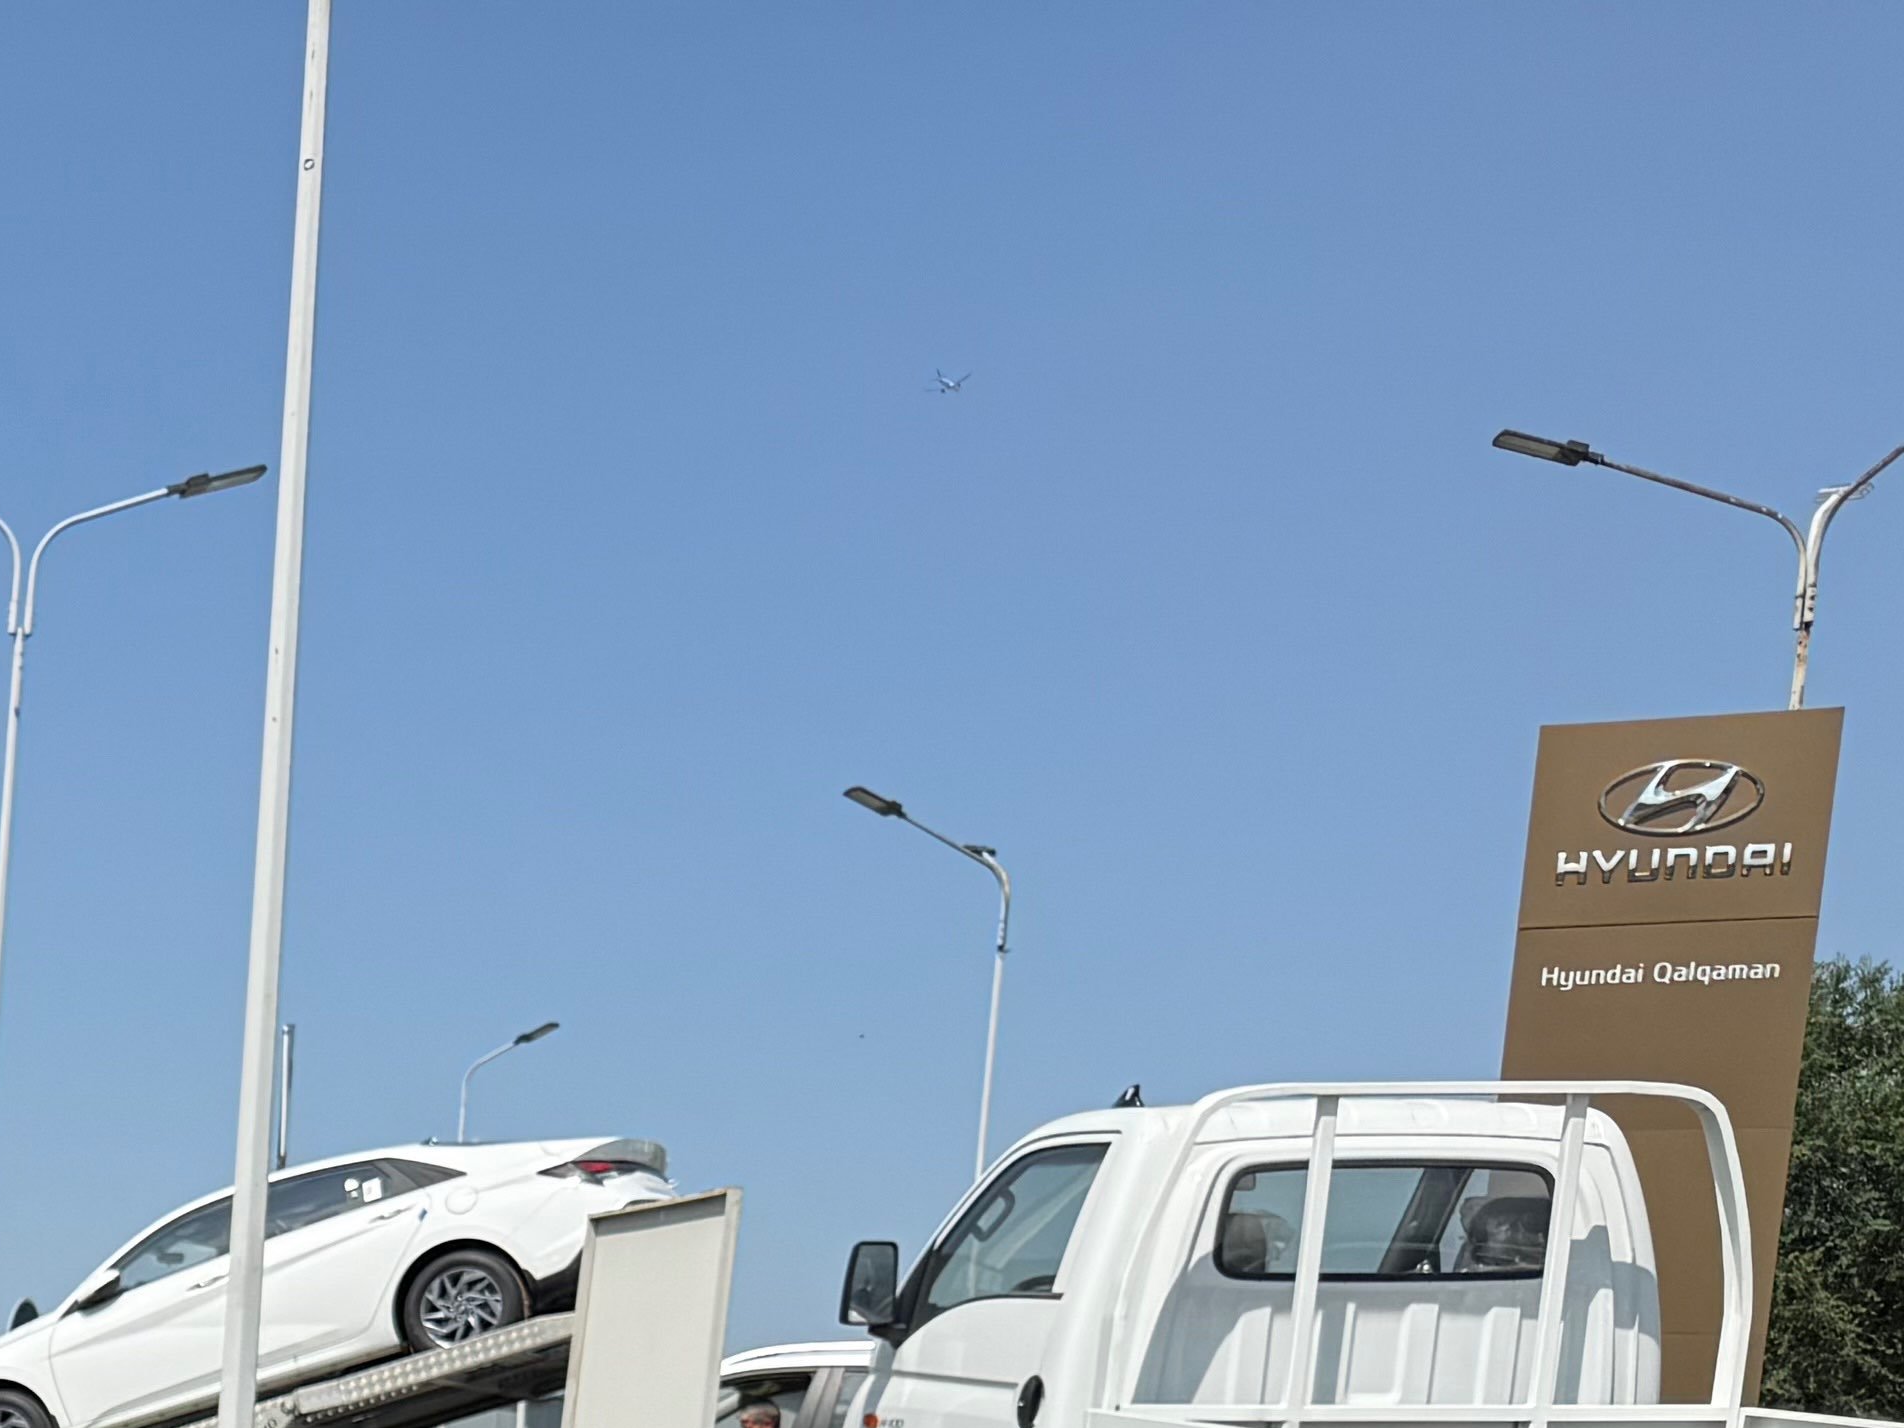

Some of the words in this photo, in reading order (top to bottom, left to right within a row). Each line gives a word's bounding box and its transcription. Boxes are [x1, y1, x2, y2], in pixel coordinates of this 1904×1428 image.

[1554, 842, 1793, 886] HYUNDAI
[1540, 962, 1645, 990] Hyundai
[1652, 960, 1781, 987] Qalqaman
